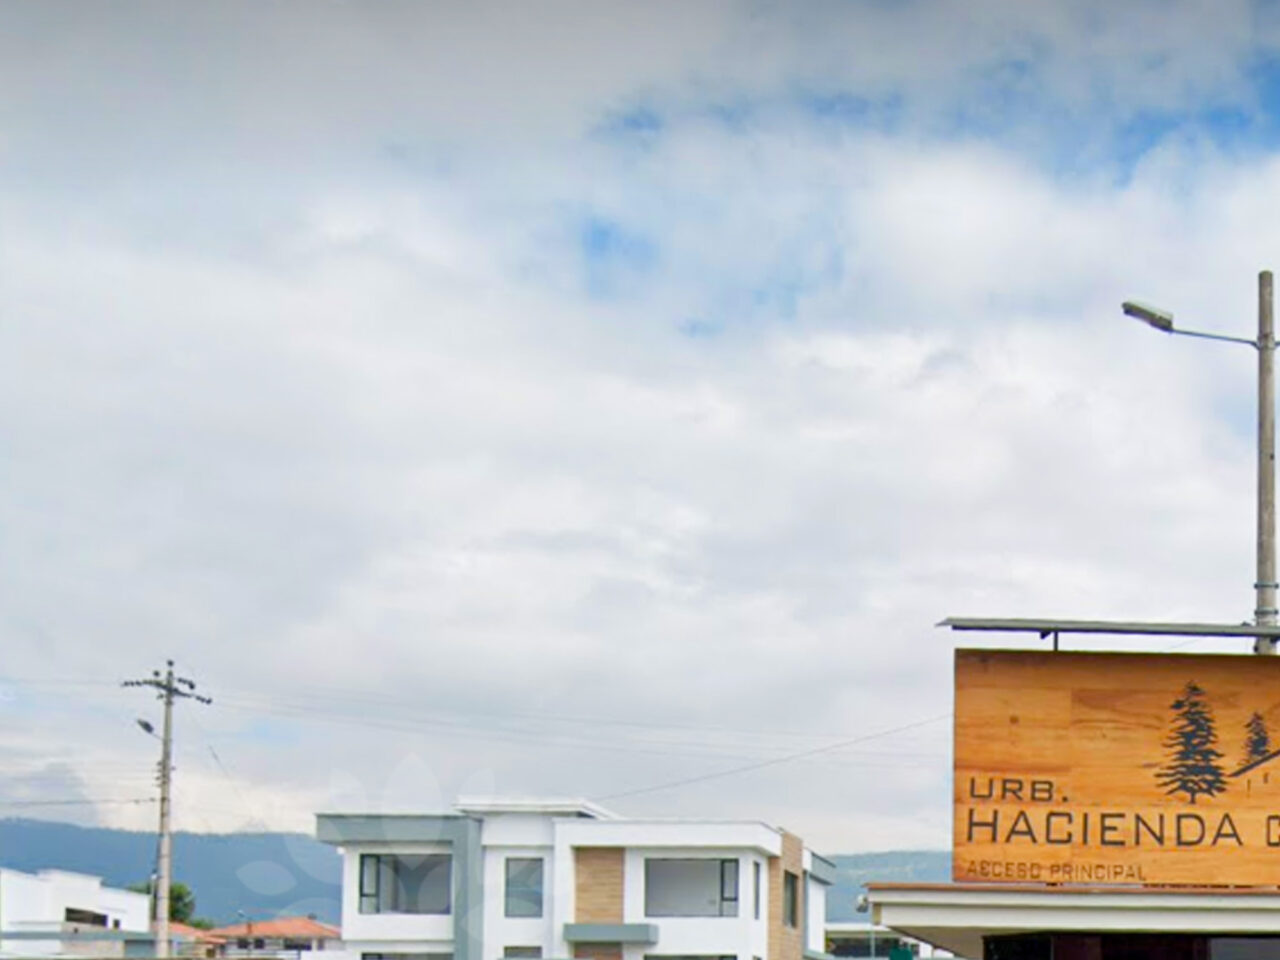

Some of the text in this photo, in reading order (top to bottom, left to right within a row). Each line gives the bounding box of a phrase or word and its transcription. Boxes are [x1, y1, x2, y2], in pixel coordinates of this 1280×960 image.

[969, 777, 1069, 803] URB.
[966, 808, 1244, 847] HACIENDA
[1049, 864, 1147, 882] PRINCIPAL
